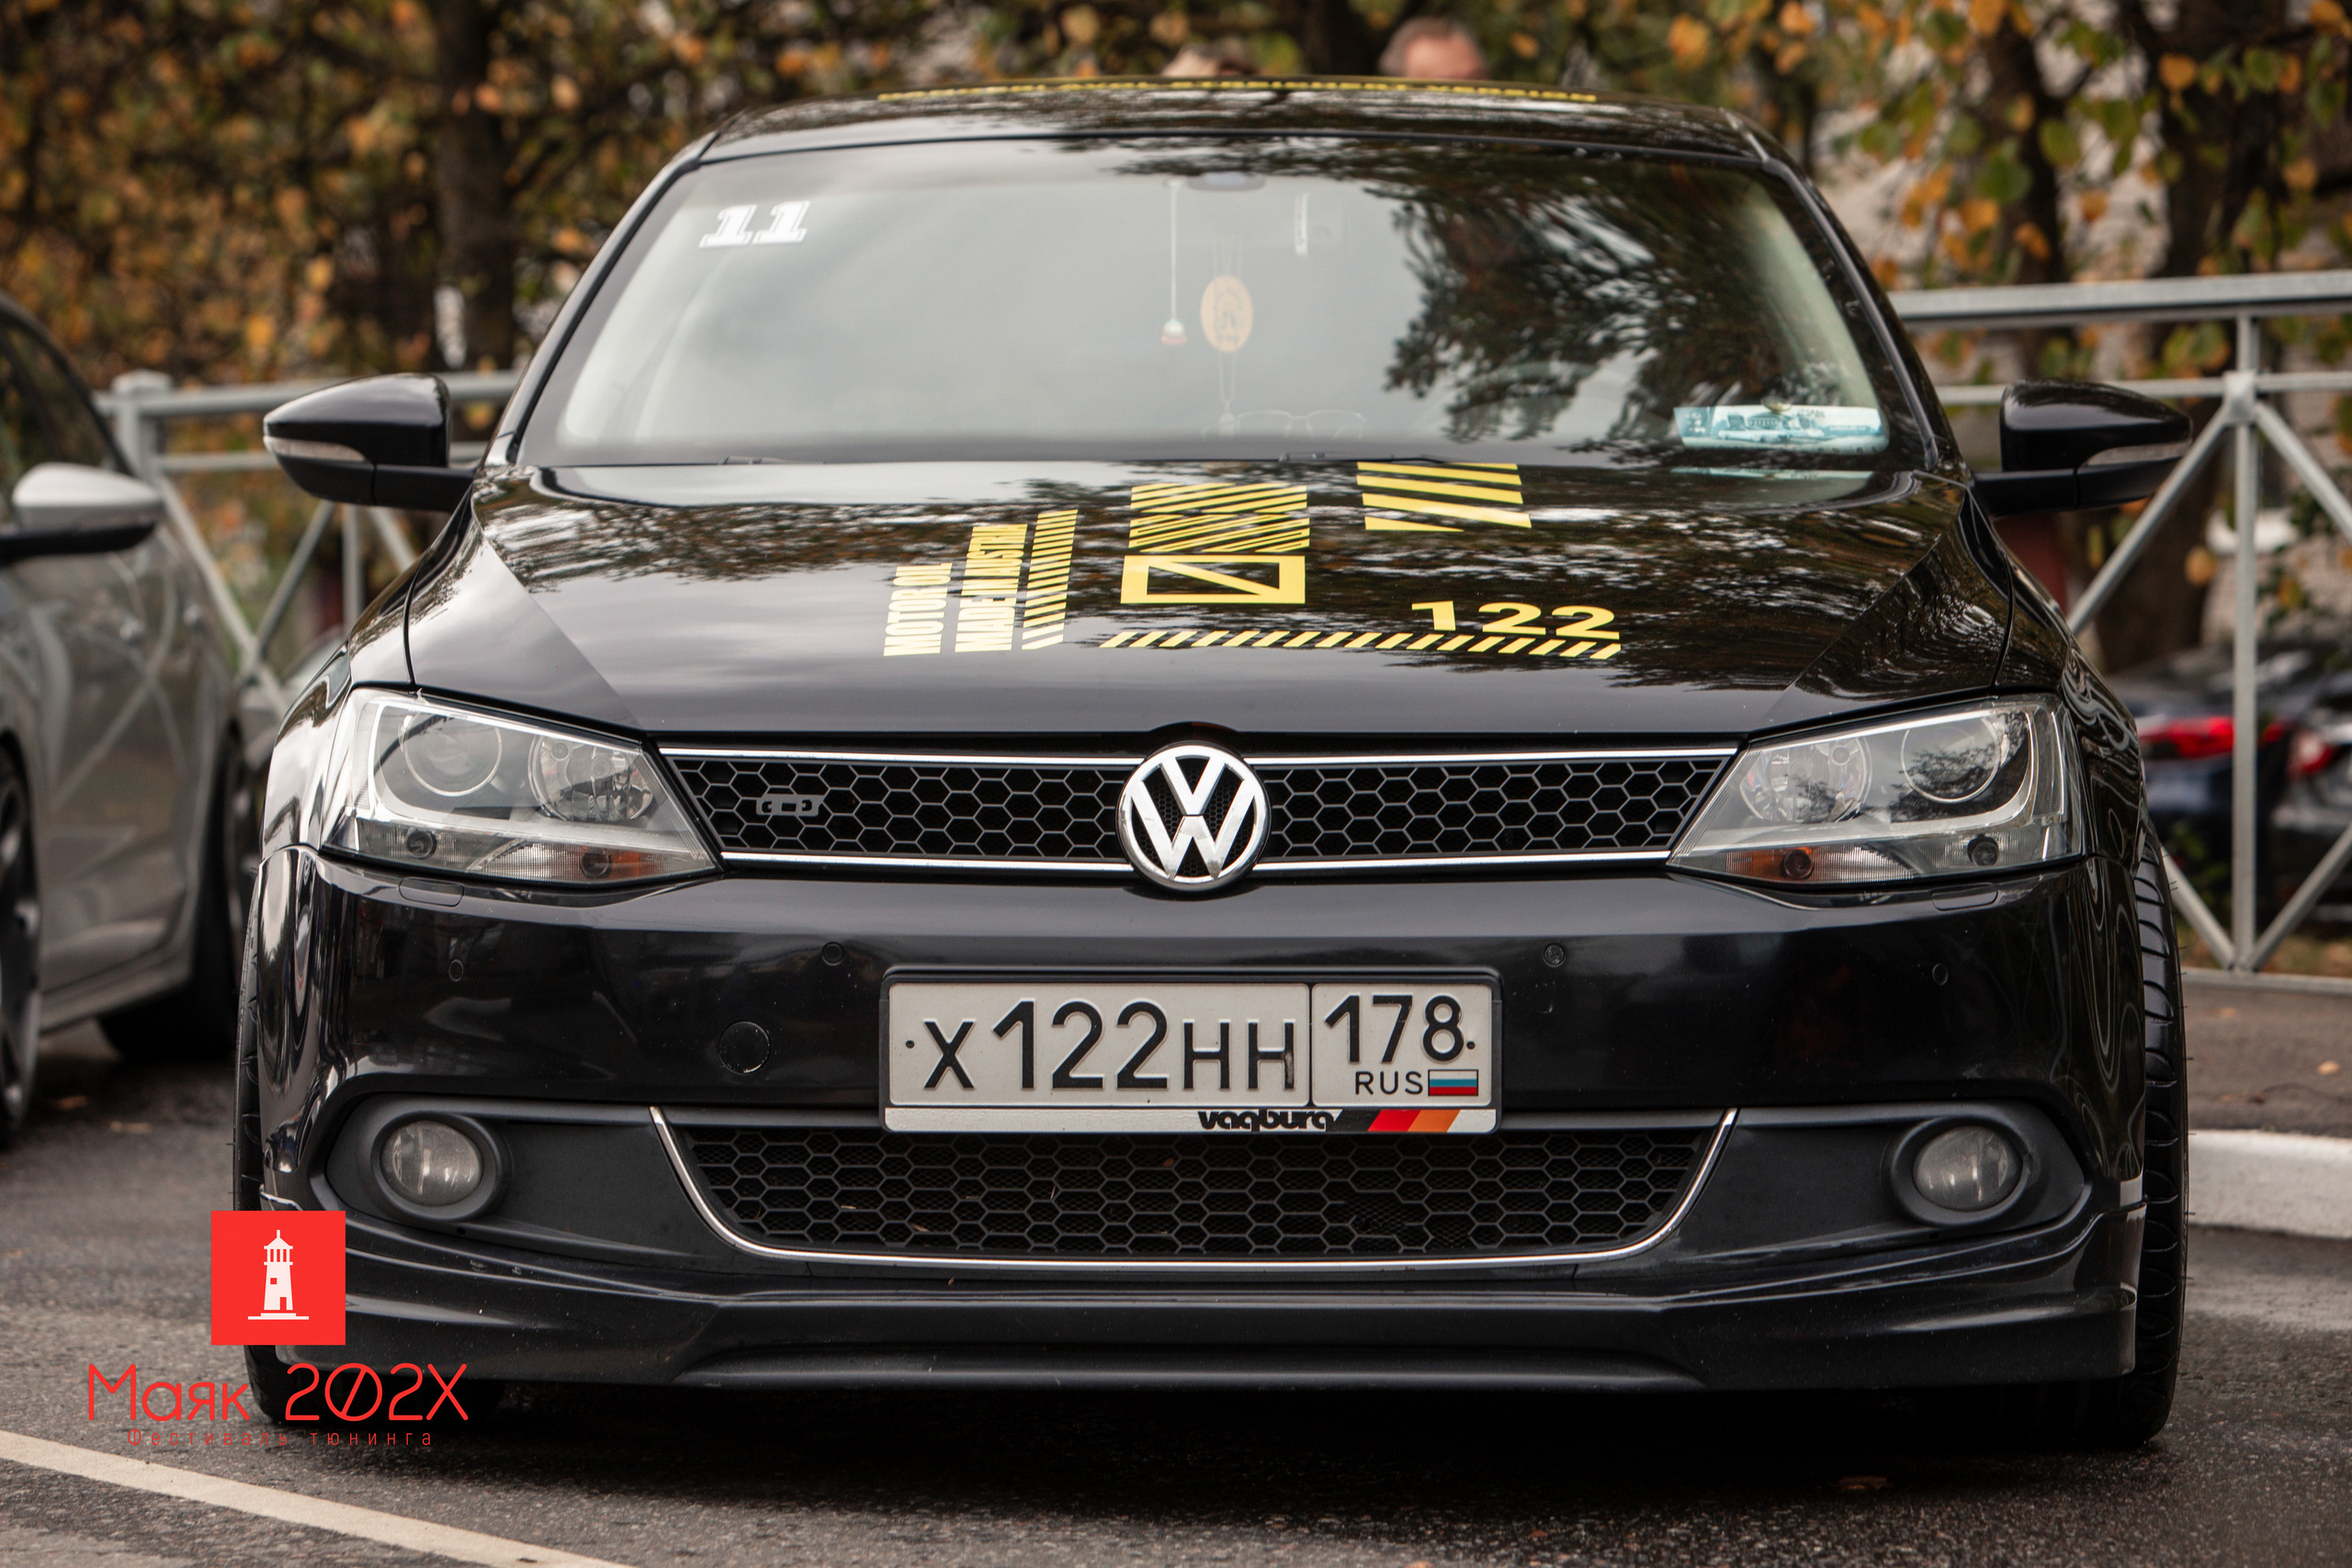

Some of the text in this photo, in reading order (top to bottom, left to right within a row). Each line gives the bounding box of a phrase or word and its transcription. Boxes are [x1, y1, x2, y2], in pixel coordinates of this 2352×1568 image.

[698, 200, 810, 249] 11
[883, 562, 953, 657] MOTOR OIL
[955, 524, 1028, 652] MADE IN AUSTRIA
[1411, 600, 1620, 639] 122
[1324, 995, 1465, 1064] 178
[1355, 1071, 1423, 1095] RUS
